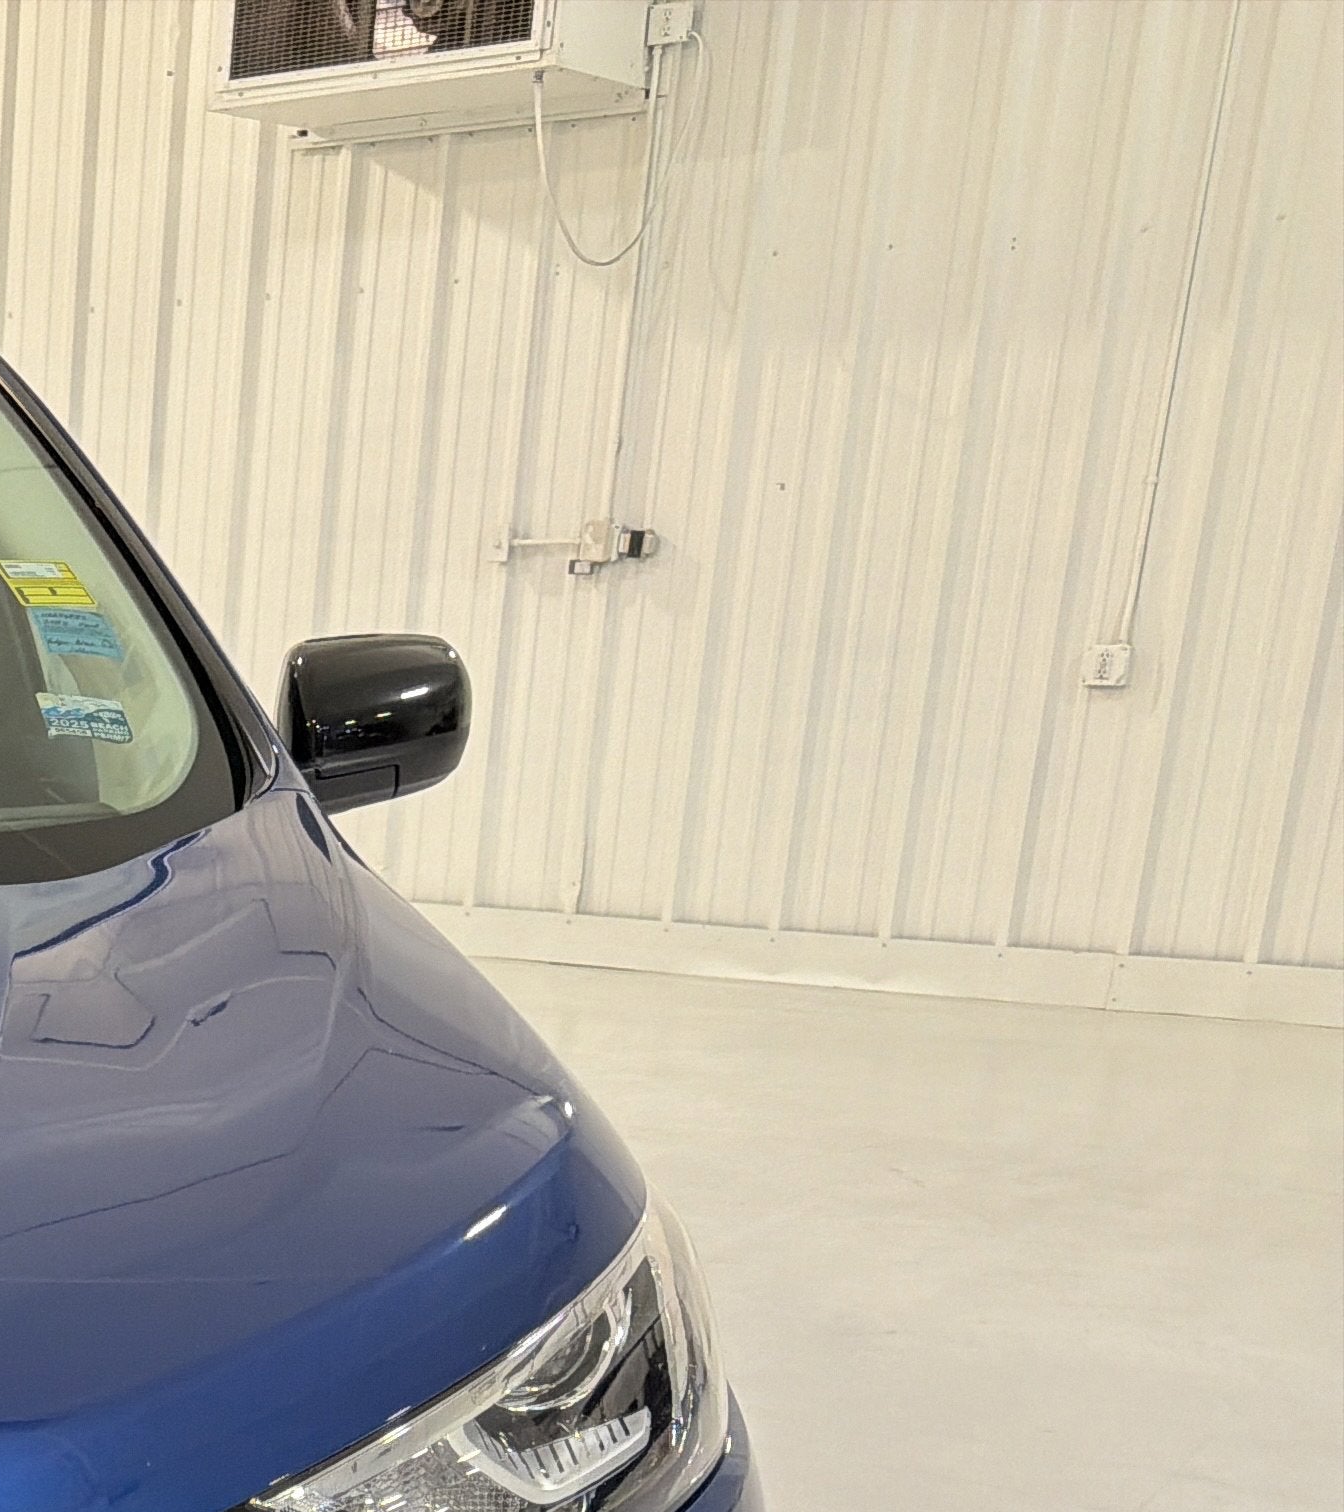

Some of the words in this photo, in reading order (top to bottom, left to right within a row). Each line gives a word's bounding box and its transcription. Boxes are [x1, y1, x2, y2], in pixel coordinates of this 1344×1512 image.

[49, 718, 89, 729] 2025
[90, 721, 129, 732] BEACH
[93, 732, 131, 743] PERMIT
